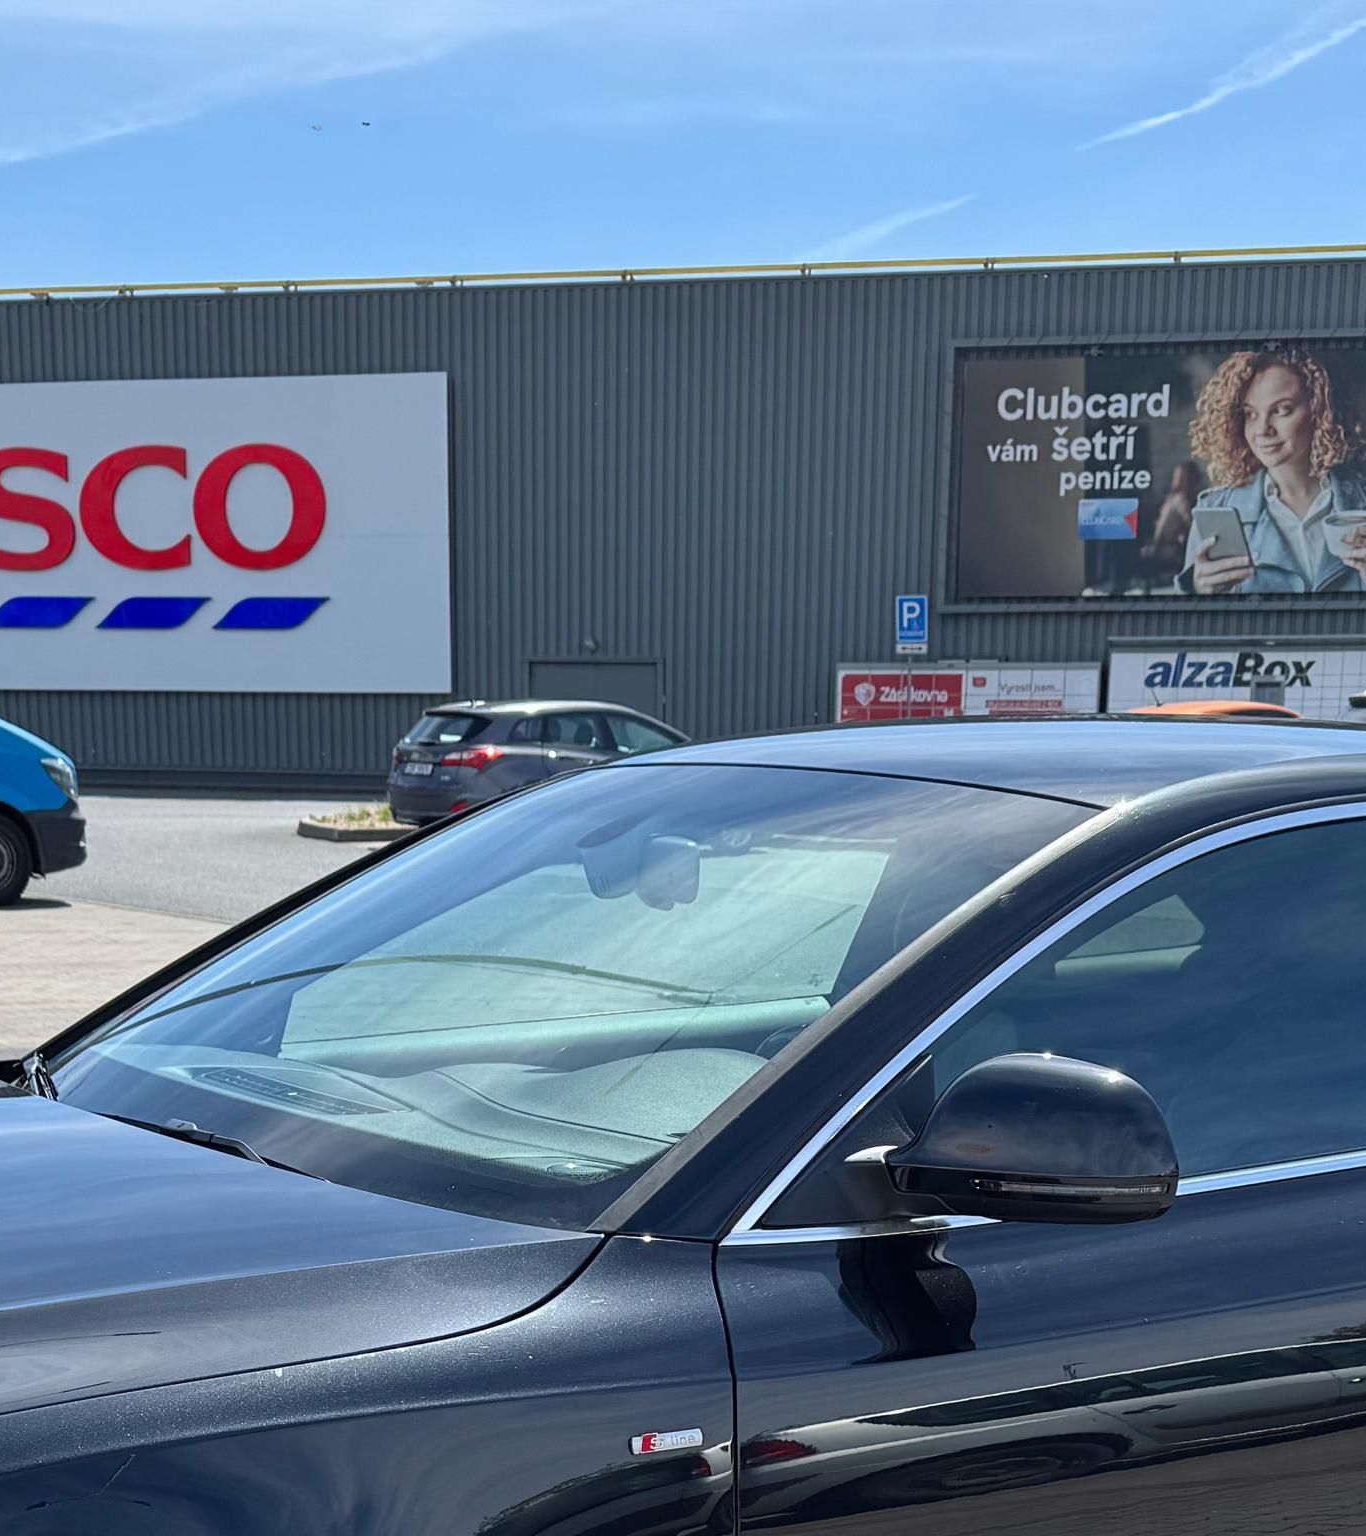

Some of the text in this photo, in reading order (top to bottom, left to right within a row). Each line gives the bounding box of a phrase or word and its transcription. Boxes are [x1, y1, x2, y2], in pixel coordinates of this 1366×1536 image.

[997, 383, 1171, 421] Clubcard
[986, 424, 1138, 463] vám šetří
[1059, 464, 1152, 497] peníze
[902, 601, 921, 628] P
[1144, 651, 1316, 689] alzaBox
[879, 685, 948, 703] Zásikovna
[671, 1434, 696, 1447] line
